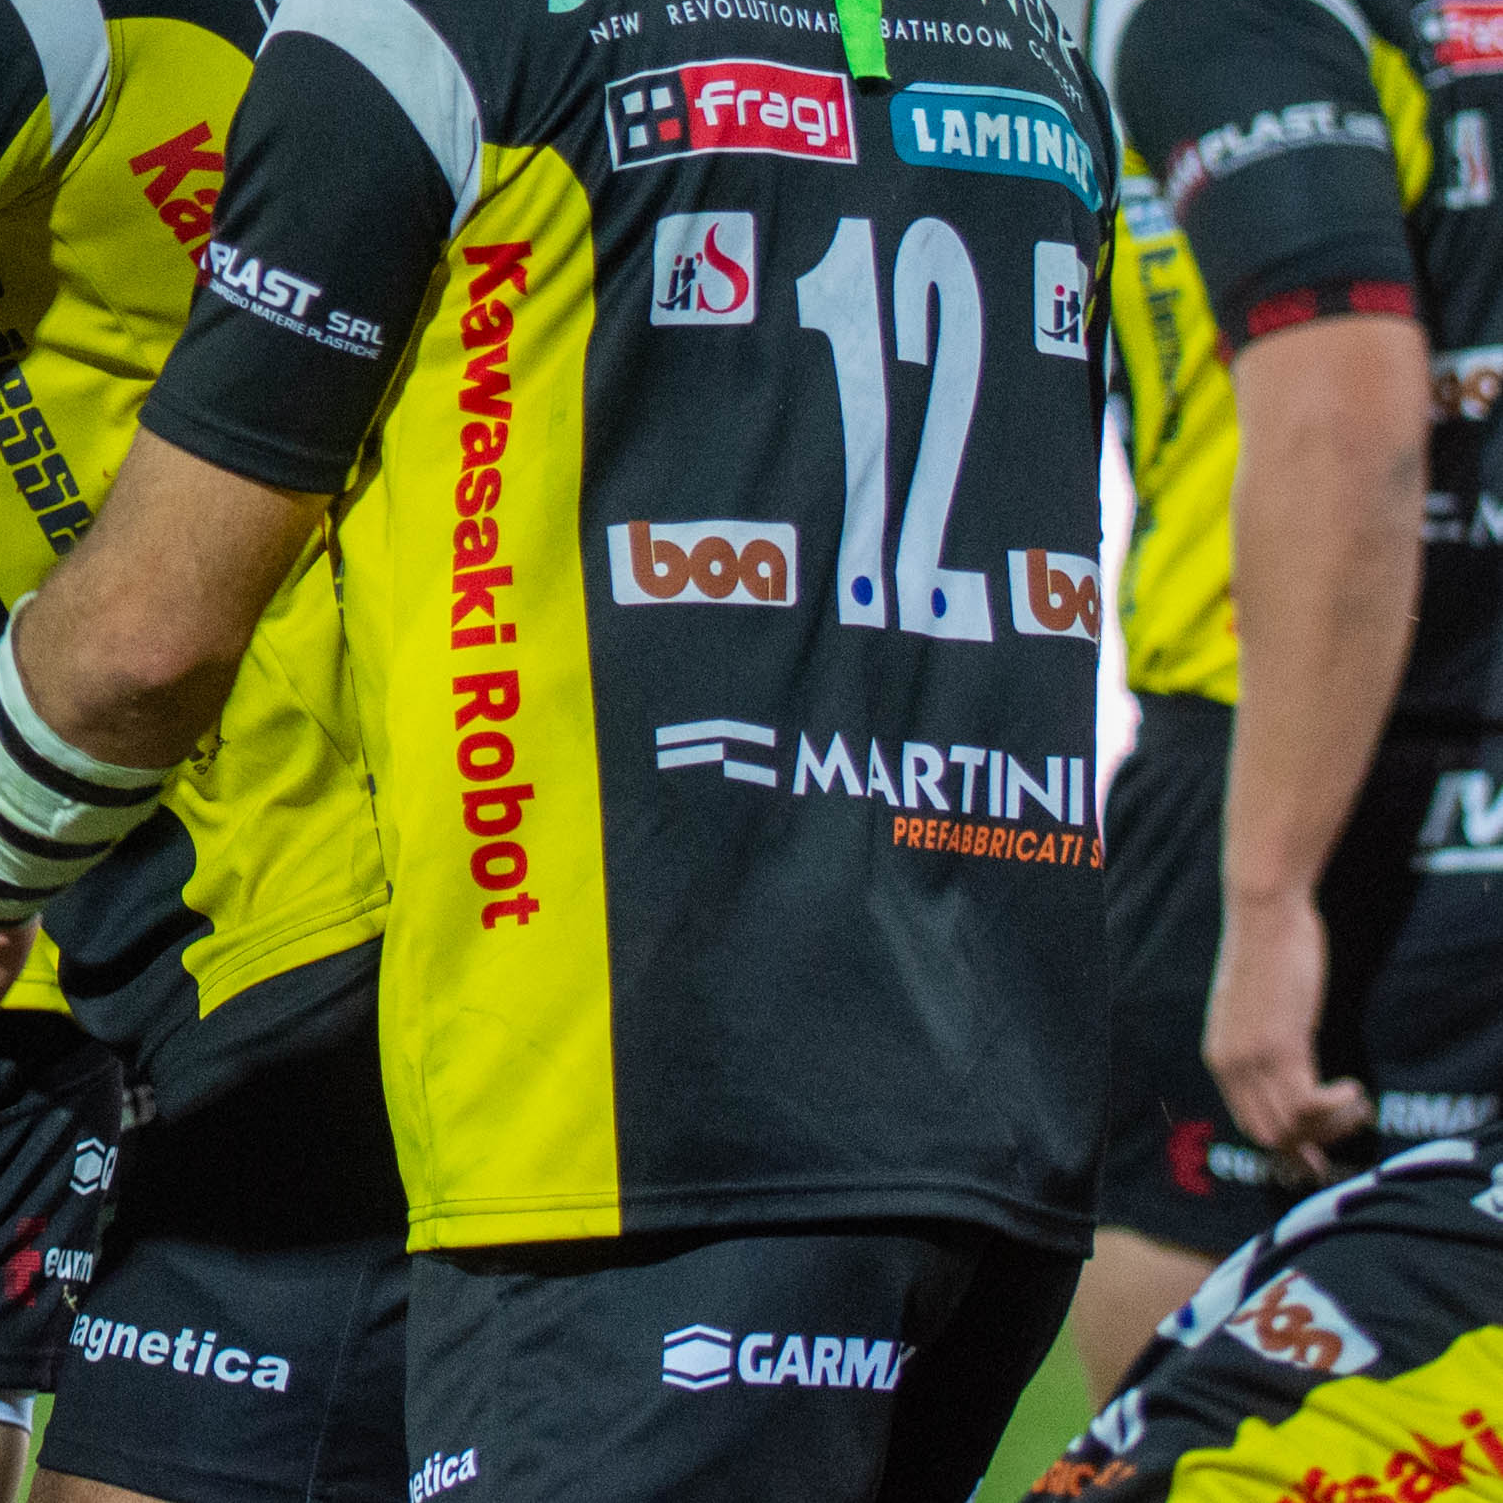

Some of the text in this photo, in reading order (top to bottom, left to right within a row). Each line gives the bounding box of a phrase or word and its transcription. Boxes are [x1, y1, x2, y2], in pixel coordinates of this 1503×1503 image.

[589, 10, 641, 46] NEW
[879, 17, 1014, 53] BATHROOM
[325, 309, 385, 346] SRL
[794, 215, 994, 643] 12
[449, 239, 541, 931] Kawasaki Robot
[627, 519, 789, 603] boa
[792, 729, 1085, 826] MARTINI
[892, 815, 1083, 868] PREFABBRICATI
[69, 1311, 292, 1393] agnetica
[737, 1332, 915, 1391] GARM
[408, 1446, 478, 1503] etica
